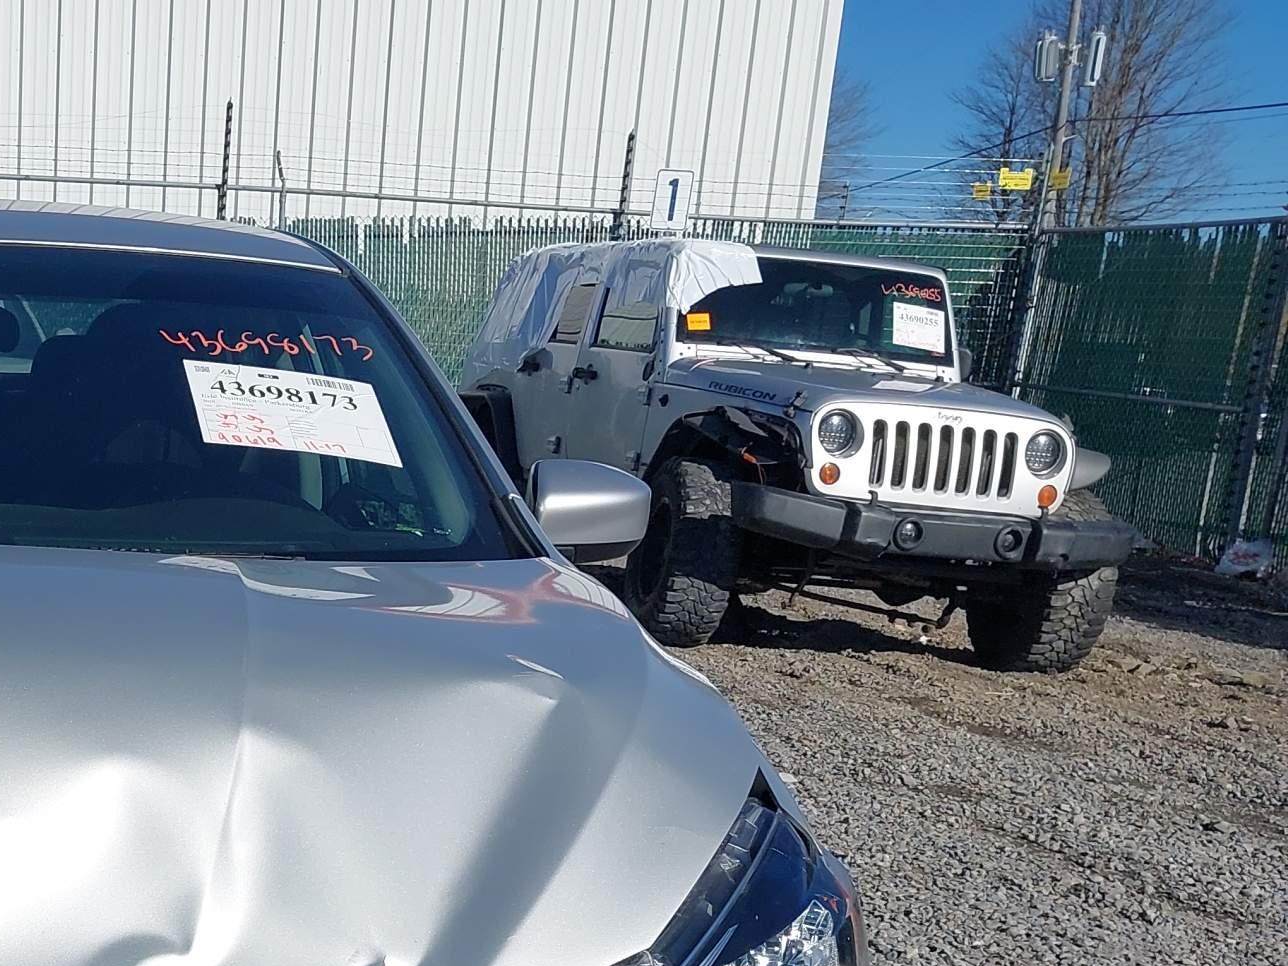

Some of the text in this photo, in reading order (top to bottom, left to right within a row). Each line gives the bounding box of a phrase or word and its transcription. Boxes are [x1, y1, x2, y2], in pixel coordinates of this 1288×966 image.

[668, 178, 680, 221] 1
[160, 329, 374, 361] 43698173
[210, 380, 358, 411] 43698173
[708, 381, 777, 401] RUBICON
